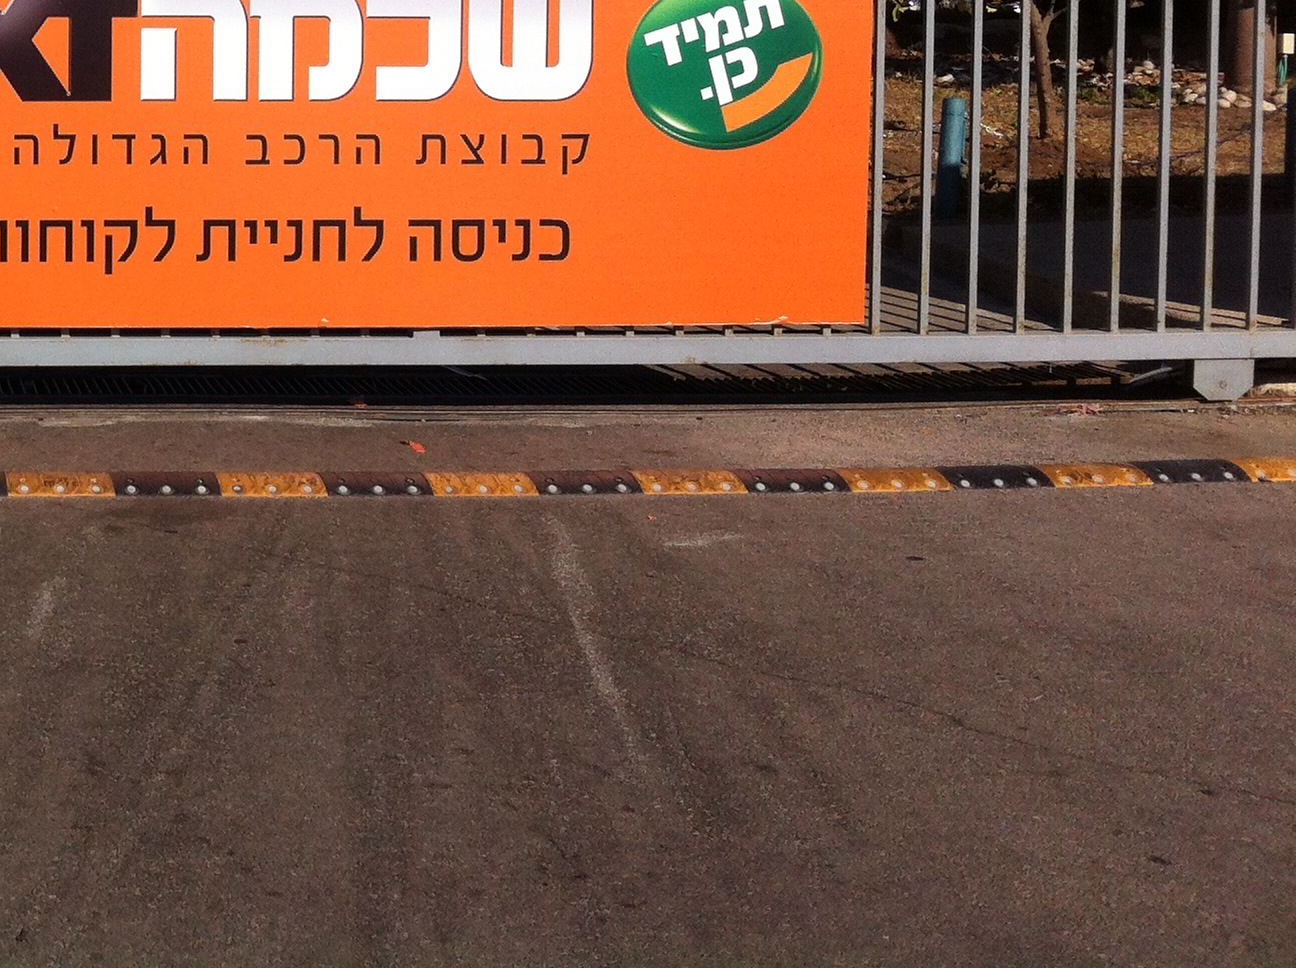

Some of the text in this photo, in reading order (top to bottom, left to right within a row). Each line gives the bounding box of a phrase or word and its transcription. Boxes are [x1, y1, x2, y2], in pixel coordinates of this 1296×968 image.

[14, 124, 208, 164] הגדולה
[246, 135, 380, 164] הרכב
[416, 134, 589, 174] קבוצת
[196, 207, 384, 262] לחניית
[409, 219, 570, 262] כניסה
